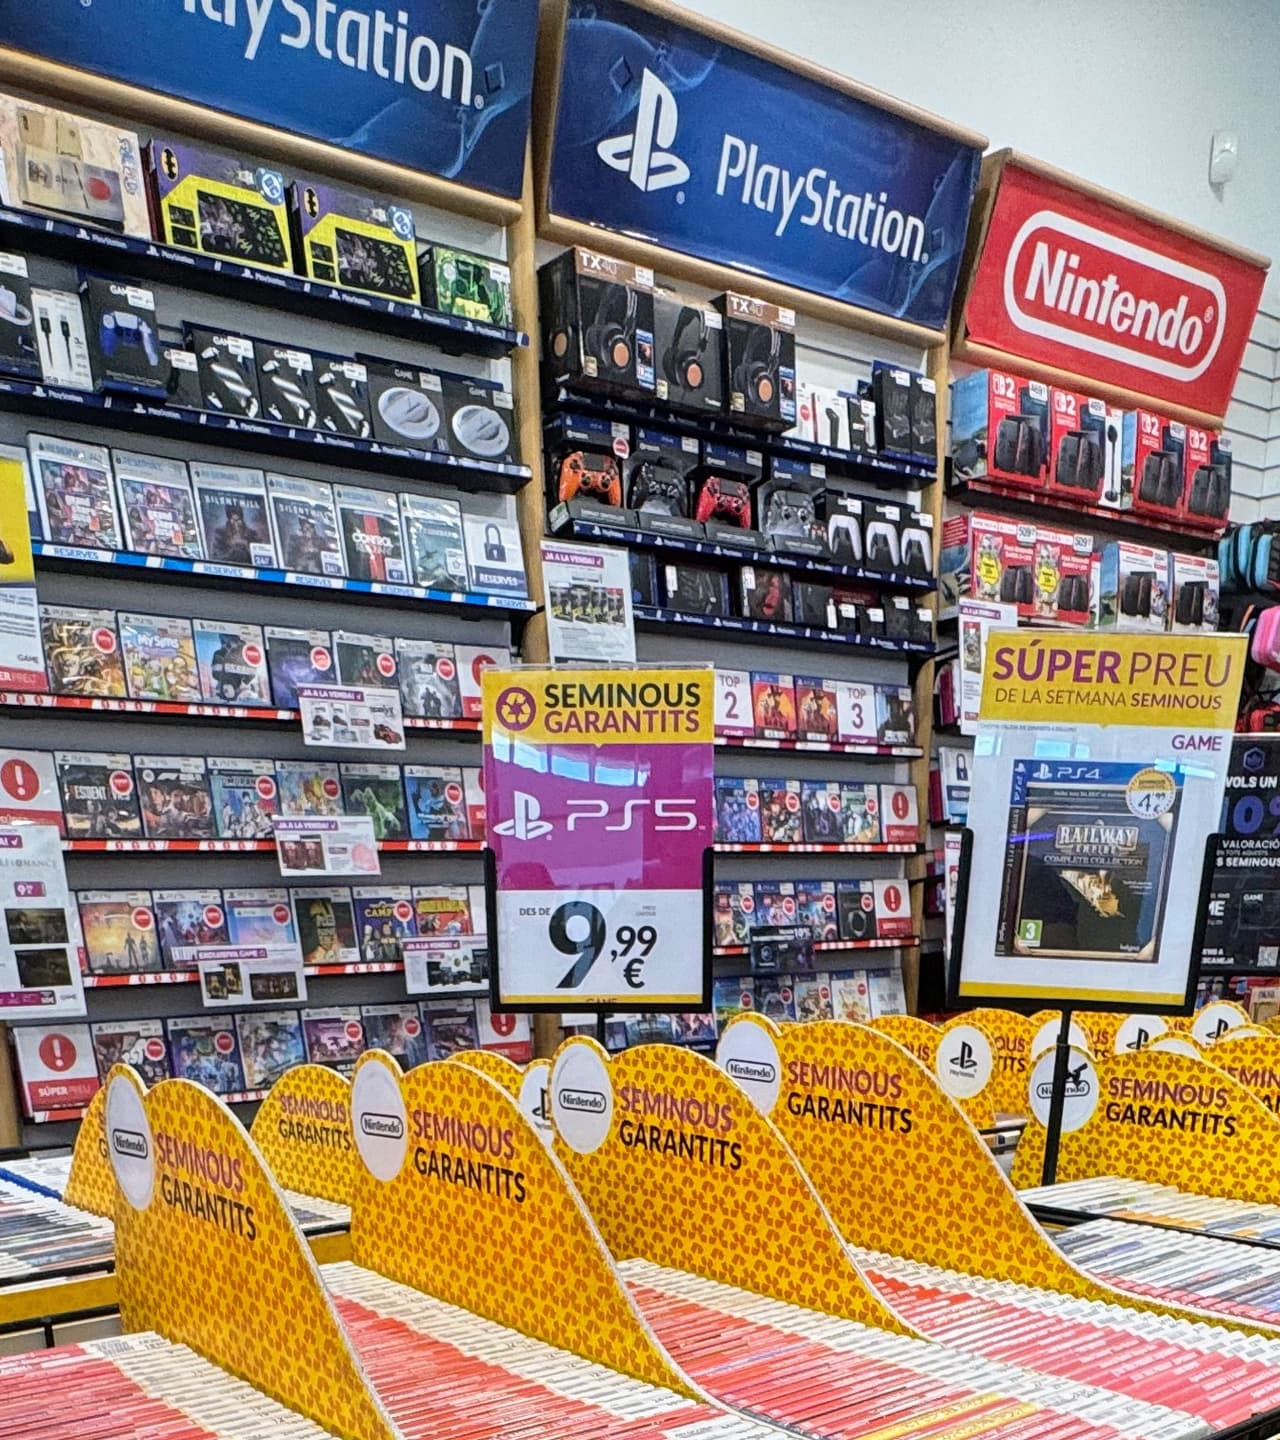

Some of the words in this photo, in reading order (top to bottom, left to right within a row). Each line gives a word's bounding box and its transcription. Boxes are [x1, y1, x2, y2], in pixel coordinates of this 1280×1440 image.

[183, 0, 473, 106] yStation
[717, 133, 925, 263] PlayStation
[1025, 241, 1204, 356] Nintendo
[994, 639, 1121, 684] SÚPER
[1129, 651, 1232, 687] PREU
[719, 674, 741, 688] TOP
[847, 687, 867, 700] TOP
[544, 683, 700, 709] SEMINOUS
[724, 692, 740, 720] 2
[995, 688, 1018, 704] DE
[1045, 690, 1127, 708] SETMANA
[1130, 692, 1222, 711] SEMINOUS
[544, 709, 700, 734] GARANTITS
[852, 702, 865, 730] 3
[1171, 734, 1223, 752] GAME
[1058, 768, 1101, 780] PS4
[1259, 776, 1277, 788] UN
[567, 800, 698, 832] PS5
[1058, 825, 1136, 849] RAILWAY
[1222, 837, 1280, 850] VALORACIÓ
[730, 1063, 773, 1079] Nintendo
[787, 1060, 902, 1099] SEMINOUS
[38, 1085, 66, 1098] SÚPER
[562, 1092, 606, 1109] Nintendo
[1108, 1076, 1228, 1109] SEMINOUS
[280, 1093, 347, 1124] SEMINOUS
[619, 1086, 733, 1132] SEMINOUS
[787, 1092, 912, 1134] GARANTITS
[1106, 1102, 1237, 1137] GARANTITS
[278, 1118, 352, 1150] GARANTITS
[364, 1118, 401, 1134] Nintendo
[413, 1109, 515, 1160] SEMINOUS
[114, 1135, 147, 1155] Nintendo
[620, 1120, 743, 1171] GARANTITS
[156, 1134, 245, 1193] SEMINOUS
[414, 1146, 526, 1203] GARANTITS
[161, 1174, 257, 1241] GARANTITS
